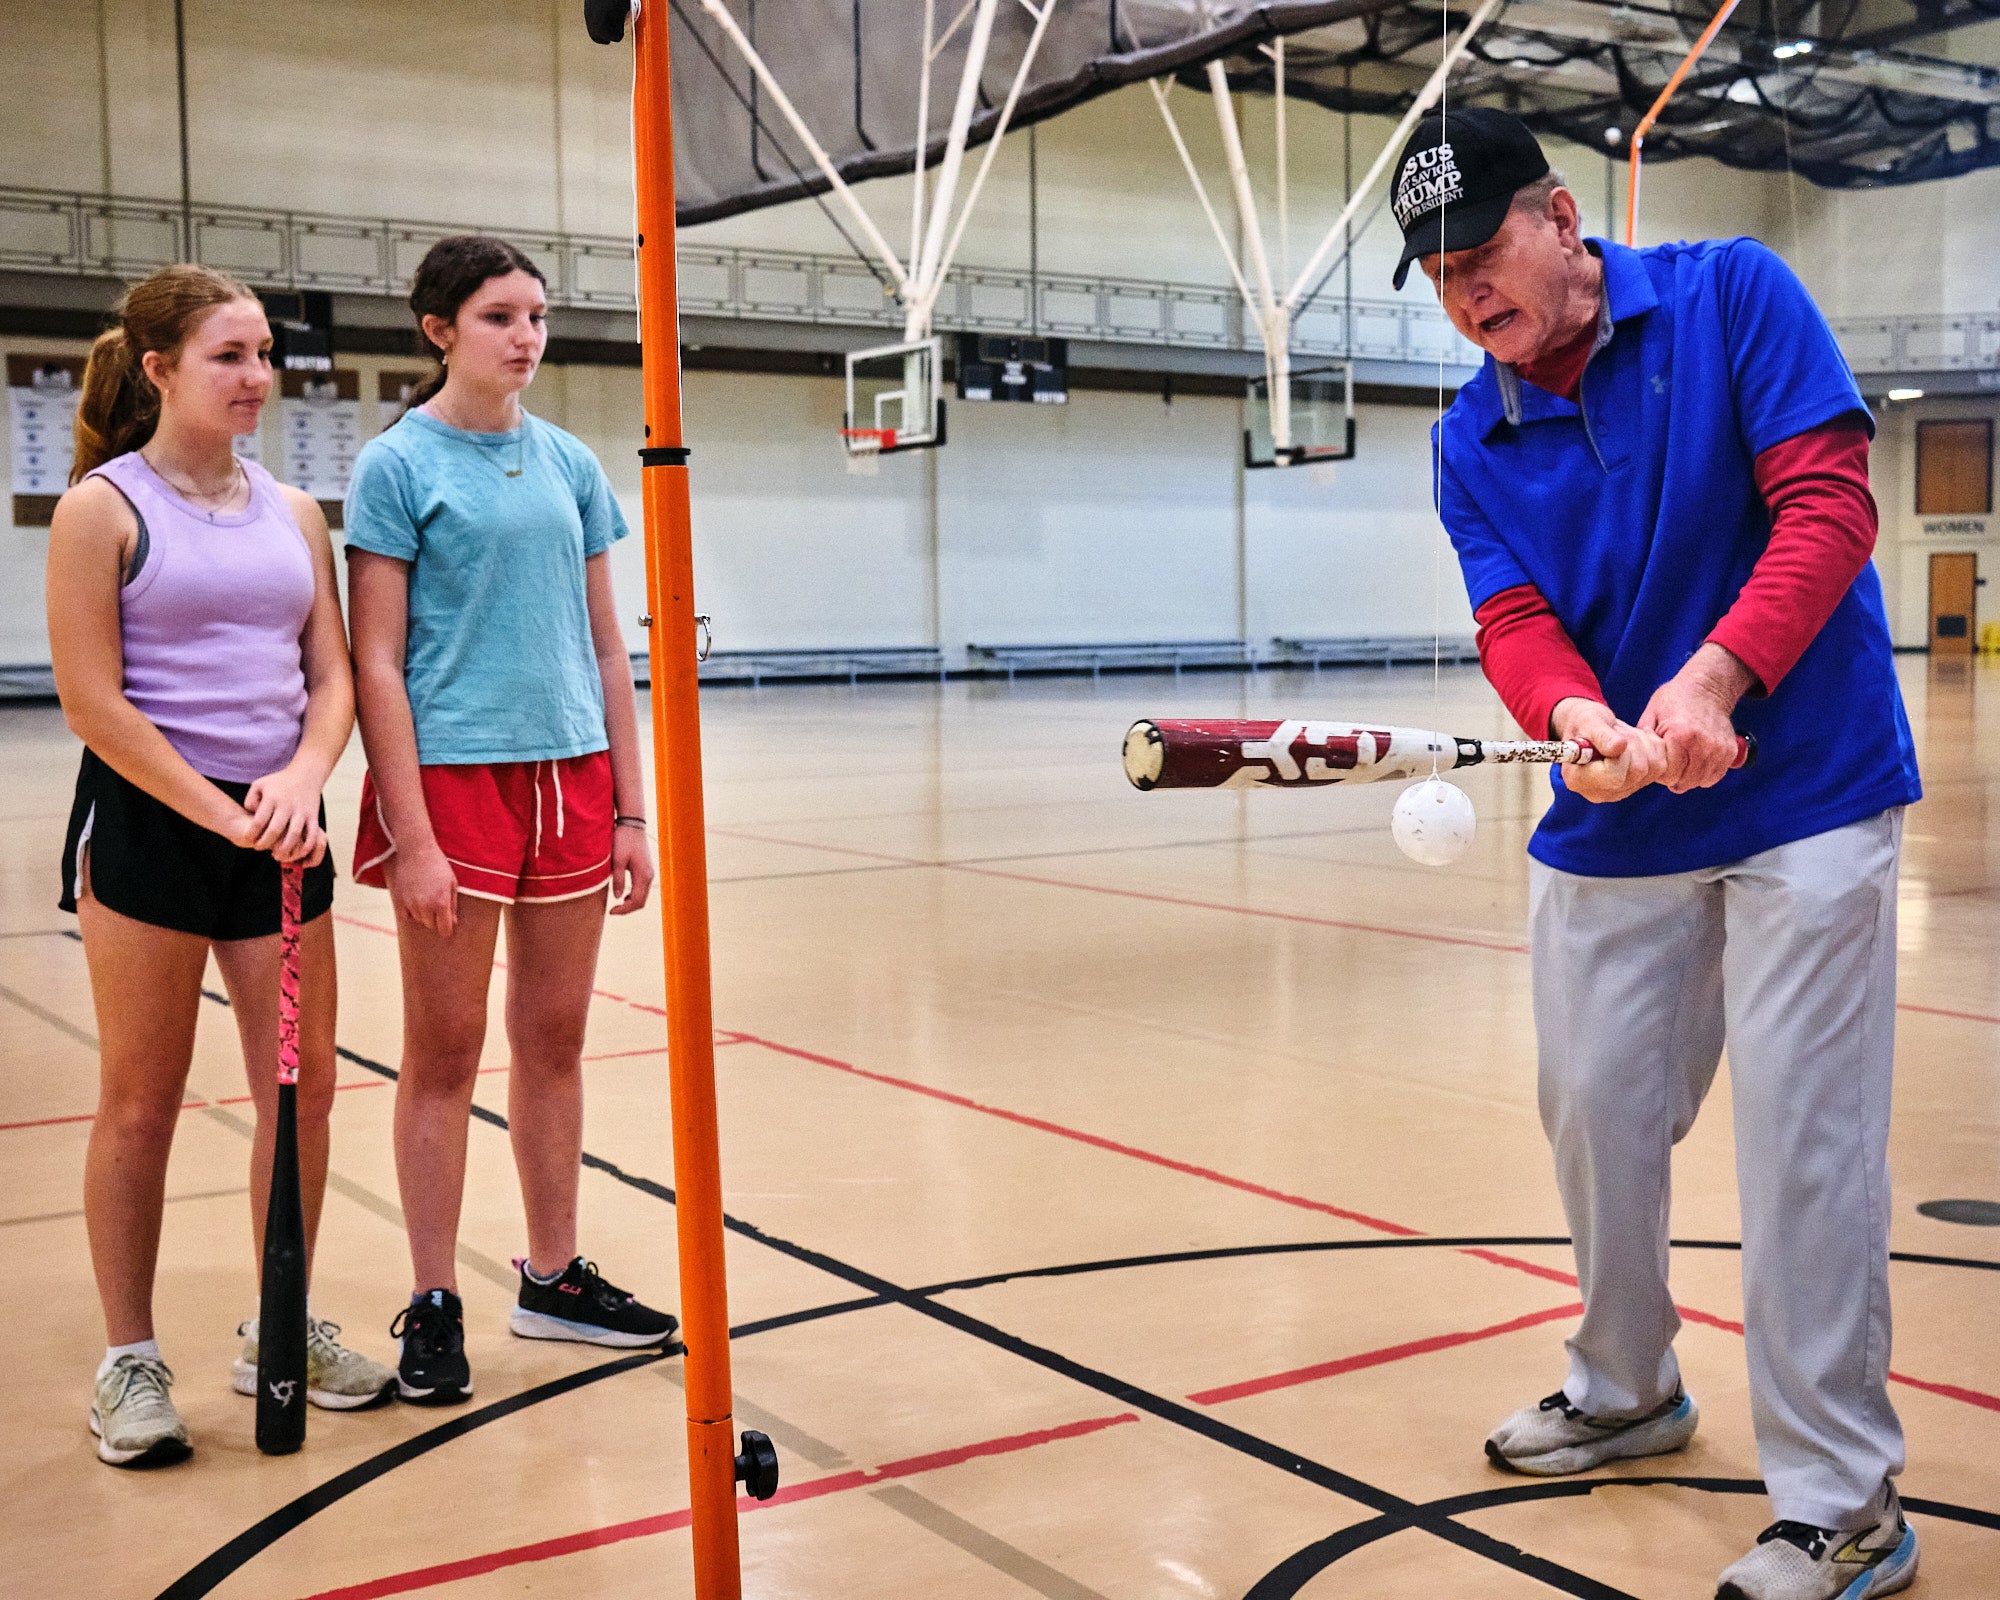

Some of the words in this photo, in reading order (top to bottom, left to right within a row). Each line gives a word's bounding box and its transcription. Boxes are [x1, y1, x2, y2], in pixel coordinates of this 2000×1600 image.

[1411, 160, 1458, 186] SAVIOR
[1393, 170, 1462, 221] TRUMP
[1411, 187, 1464, 219] PRESIDENT
